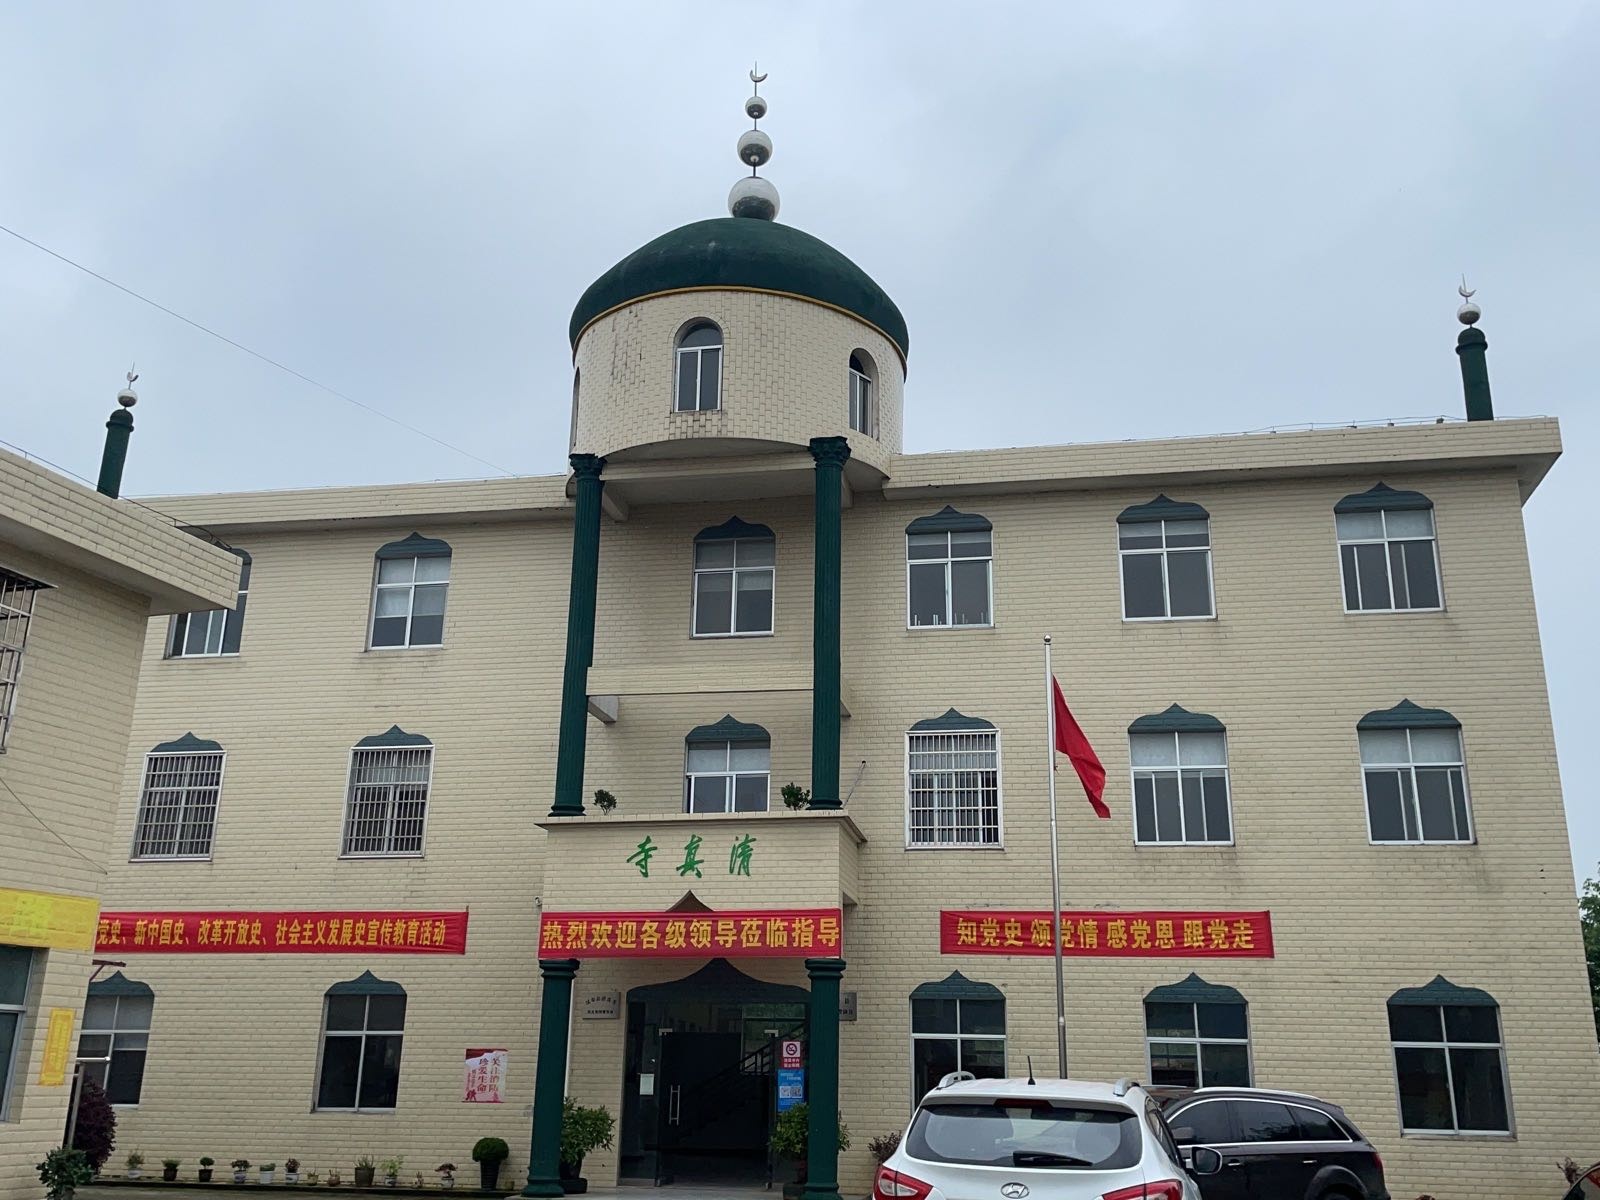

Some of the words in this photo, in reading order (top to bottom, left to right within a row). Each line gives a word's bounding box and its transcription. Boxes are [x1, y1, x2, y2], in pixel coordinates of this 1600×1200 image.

[626, 834, 757, 879] 清真寺
[541, 917, 840, 950] 热烈欢迎各级领导莅临指导
[957, 918, 1024, 947] 知党史
[1031, 918, 1099, 949] 颂党情
[1106, 918, 1176, 949] 感党恩
[1183, 919, 1255, 950] 跟党走
[477, 1057, 489, 1093] 珍爱生命
